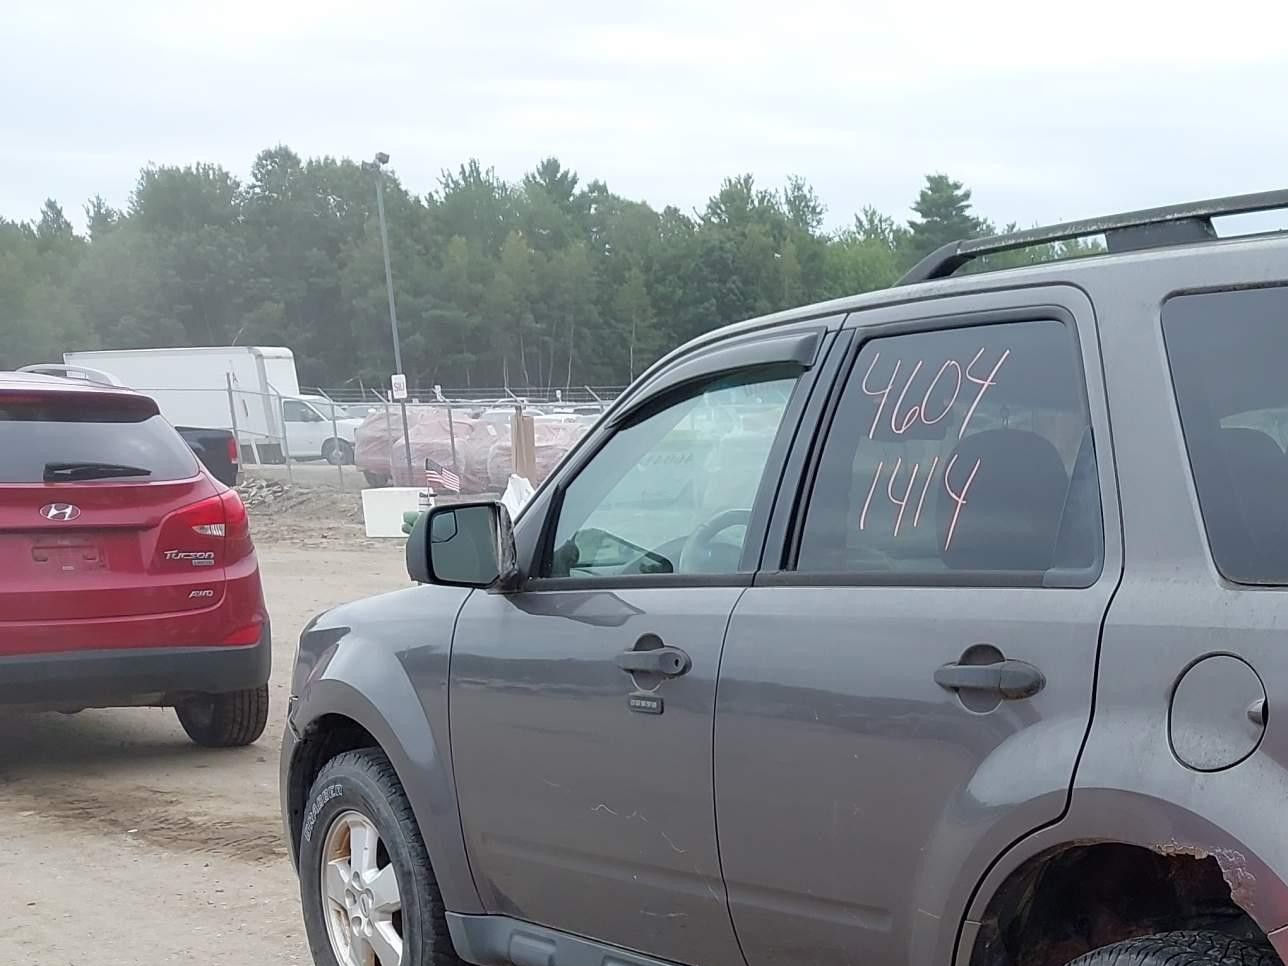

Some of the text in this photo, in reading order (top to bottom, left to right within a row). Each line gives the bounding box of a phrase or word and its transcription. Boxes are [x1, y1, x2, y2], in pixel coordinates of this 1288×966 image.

[862, 348, 1010, 439] 4604
[859, 453, 981, 551] 1414
[164, 550, 214, 559] Tucson
